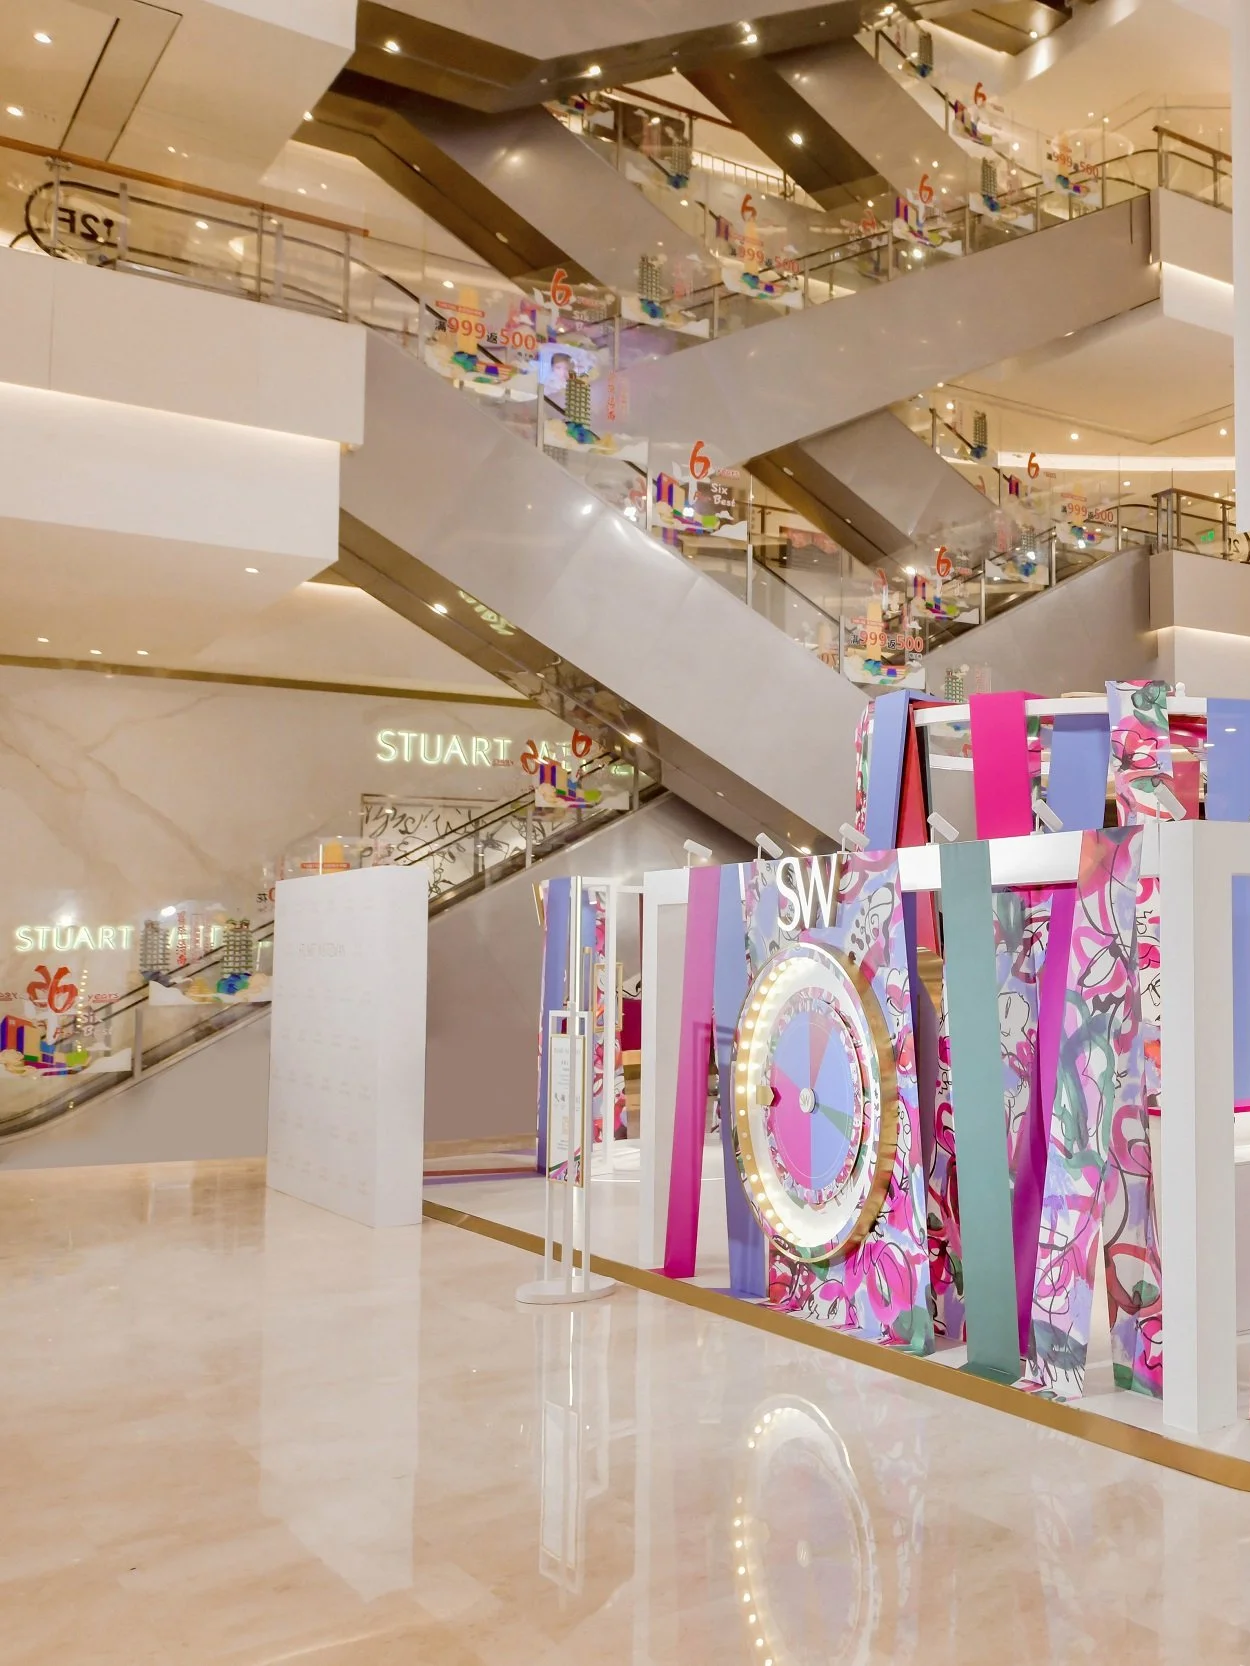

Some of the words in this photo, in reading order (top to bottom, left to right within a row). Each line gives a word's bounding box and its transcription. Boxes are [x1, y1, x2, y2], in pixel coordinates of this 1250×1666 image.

[551, 267, 574, 307] 6
[689, 440, 712, 480] 6
[710, 482, 729, 495] Six
[713, 494, 737, 508] Best
[936, 546, 953, 577] 6
[374, 728, 514, 768] STUART
[776, 853, 838, 932] SW
[15, 926, 134, 952] STUART
